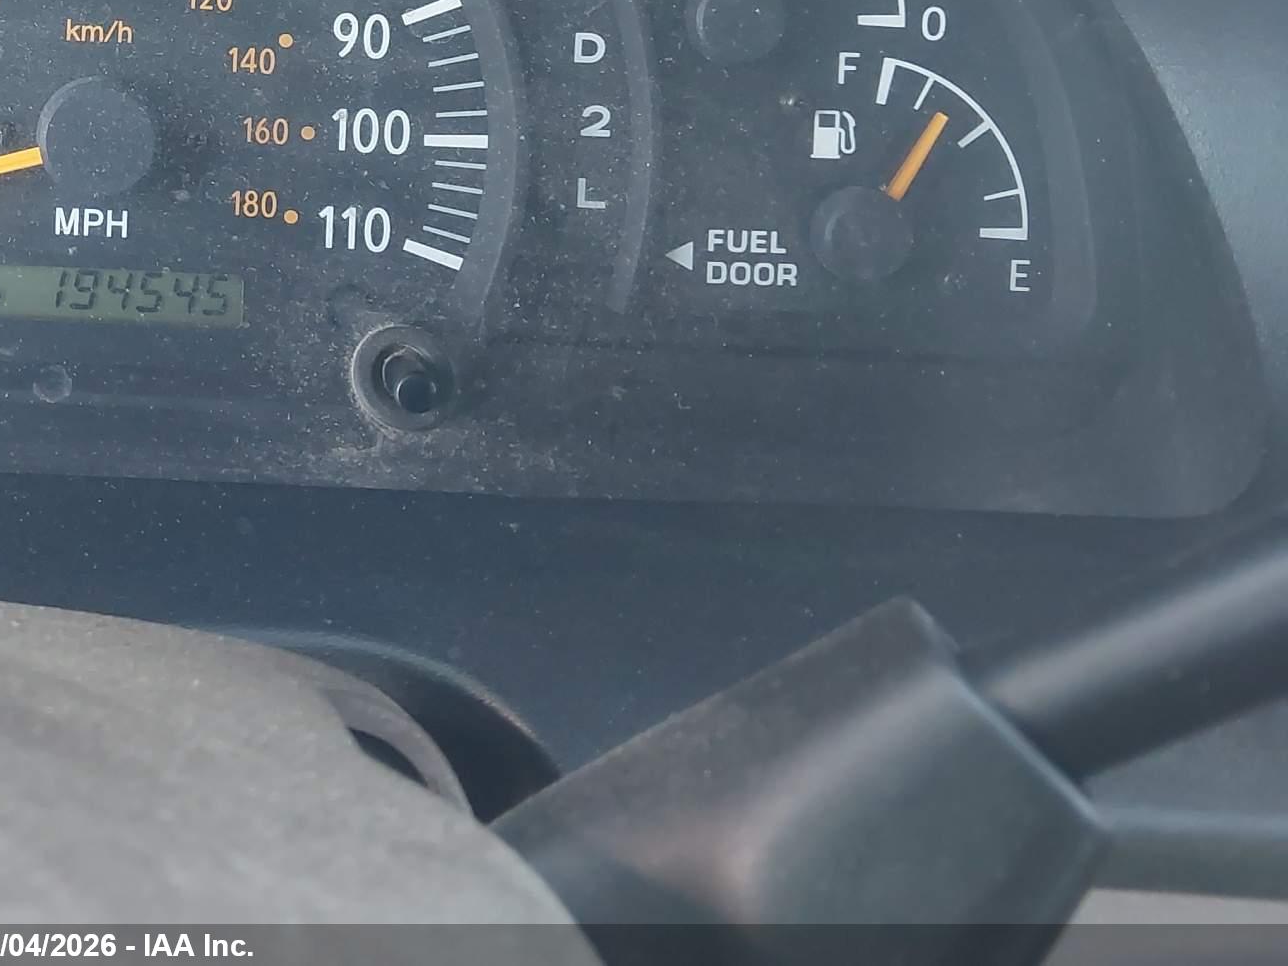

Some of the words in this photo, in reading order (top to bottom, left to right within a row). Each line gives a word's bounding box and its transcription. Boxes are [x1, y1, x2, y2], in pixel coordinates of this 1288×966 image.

[65, 18, 134, 46] km/h
[333, 12, 391, 60] 90
[921, 6, 947, 41] 0
[228, 47, 276, 76] 140
[573, 33, 607, 64] D
[838, 52, 861, 84] F
[242, 118, 289, 146] 160
[332, 108, 411, 155] 100
[580, 105, 611, 138] 2
[231, 190, 278, 218] 180
[576, 178, 607, 209] L
[54, 207, 129, 239] MPH
[318, 205, 391, 254] 110
[706, 230, 787, 254] FUEL
[705, 261, 799, 287] DOOR
[1011, 260, 1031, 292] E
[55, 269, 229, 316] 194545
